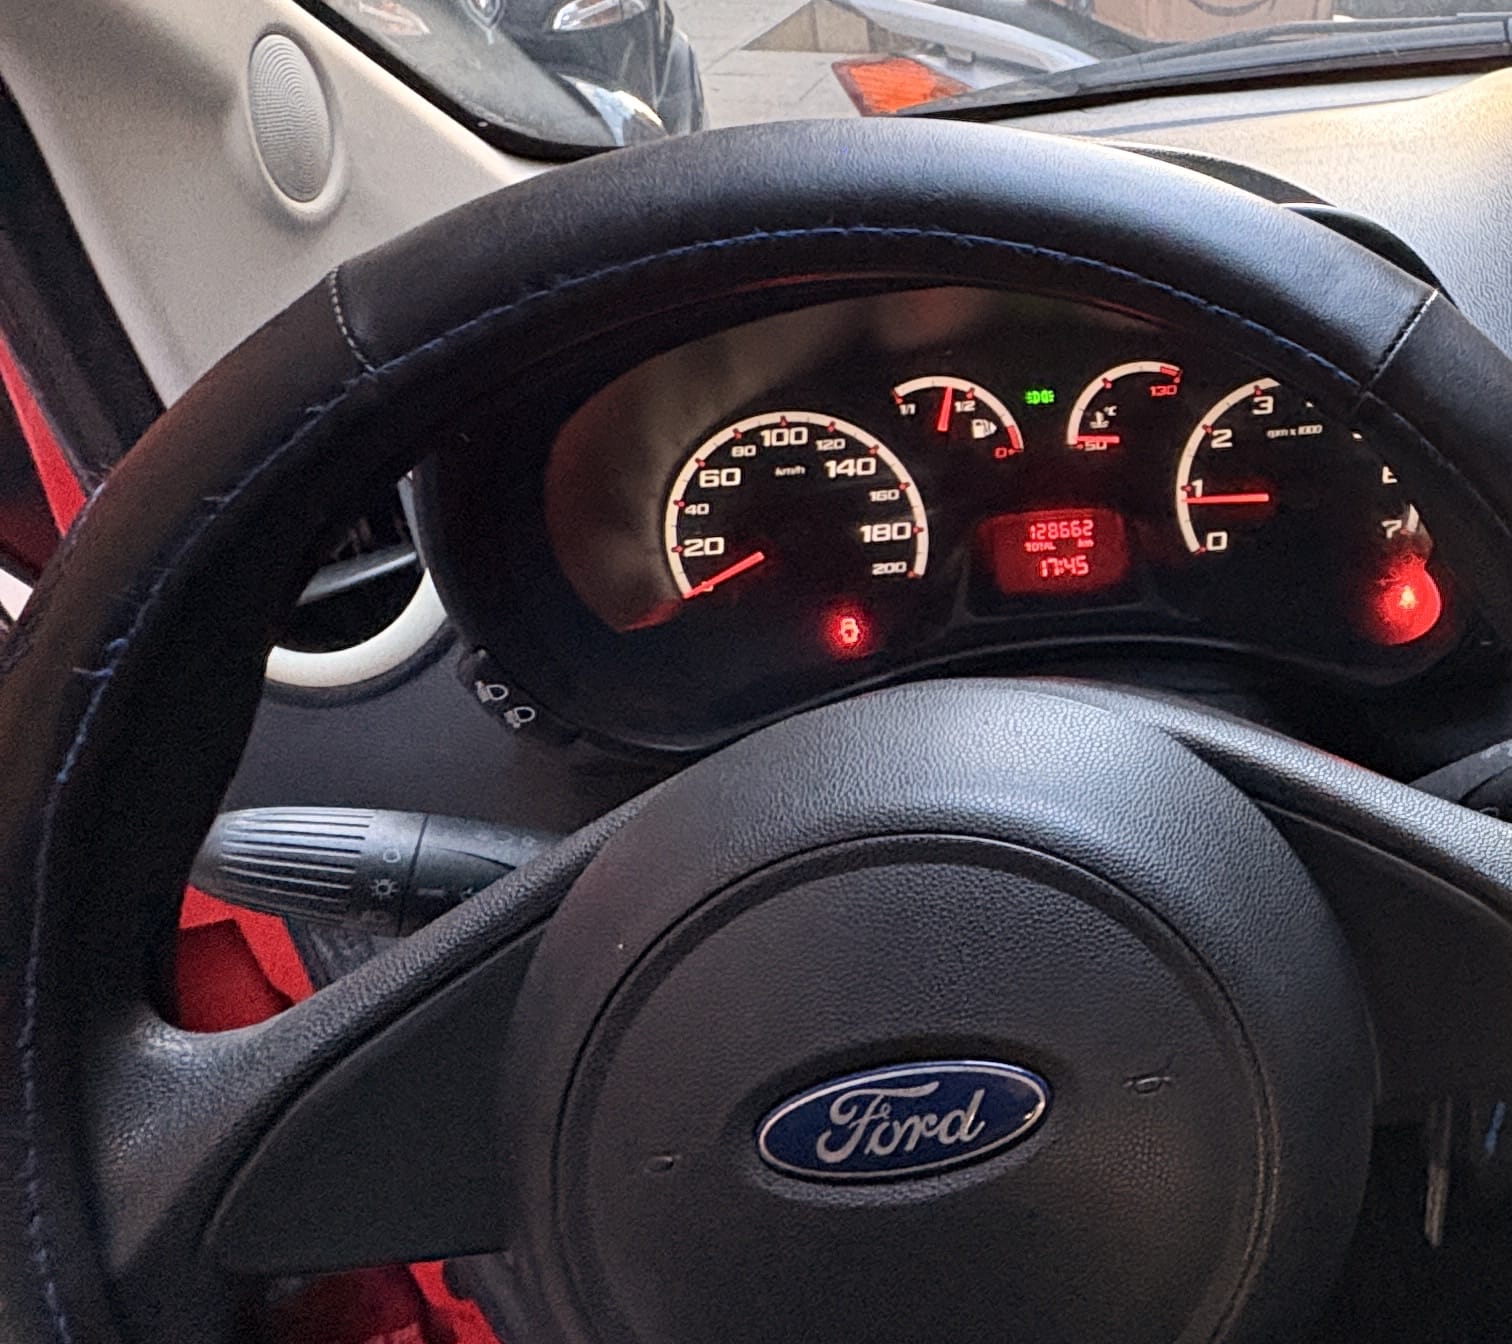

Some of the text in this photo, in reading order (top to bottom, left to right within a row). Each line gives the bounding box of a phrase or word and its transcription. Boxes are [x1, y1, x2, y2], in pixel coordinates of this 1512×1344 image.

[1151, 386, 1177, 396] 130
[1252, 396, 1274, 415] 3
[760, 427, 808, 446] 100
[816, 439, 846, 450] 120
[1084, 441, 1107, 451] 50
[1211, 429, 1233, 448] 2
[731, 445, 757, 457] 80
[824, 457, 876, 478] 140
[700, 468, 741, 487] 60
[869, 490, 900, 501] 160
[1192, 479, 1203, 498] 1
[685, 504, 710, 515] 40
[859, 522, 911, 542] 180
[1029, 519, 1094, 540] 128662
[1381, 519, 1402, 538] 7
[683, 537, 725, 556] 20
[1206, 531, 1228, 551] 0
[872, 561, 907, 575] 200
[1041, 555, 1089, 577] 17:45
[816, 1080, 985, 1163] Ford
